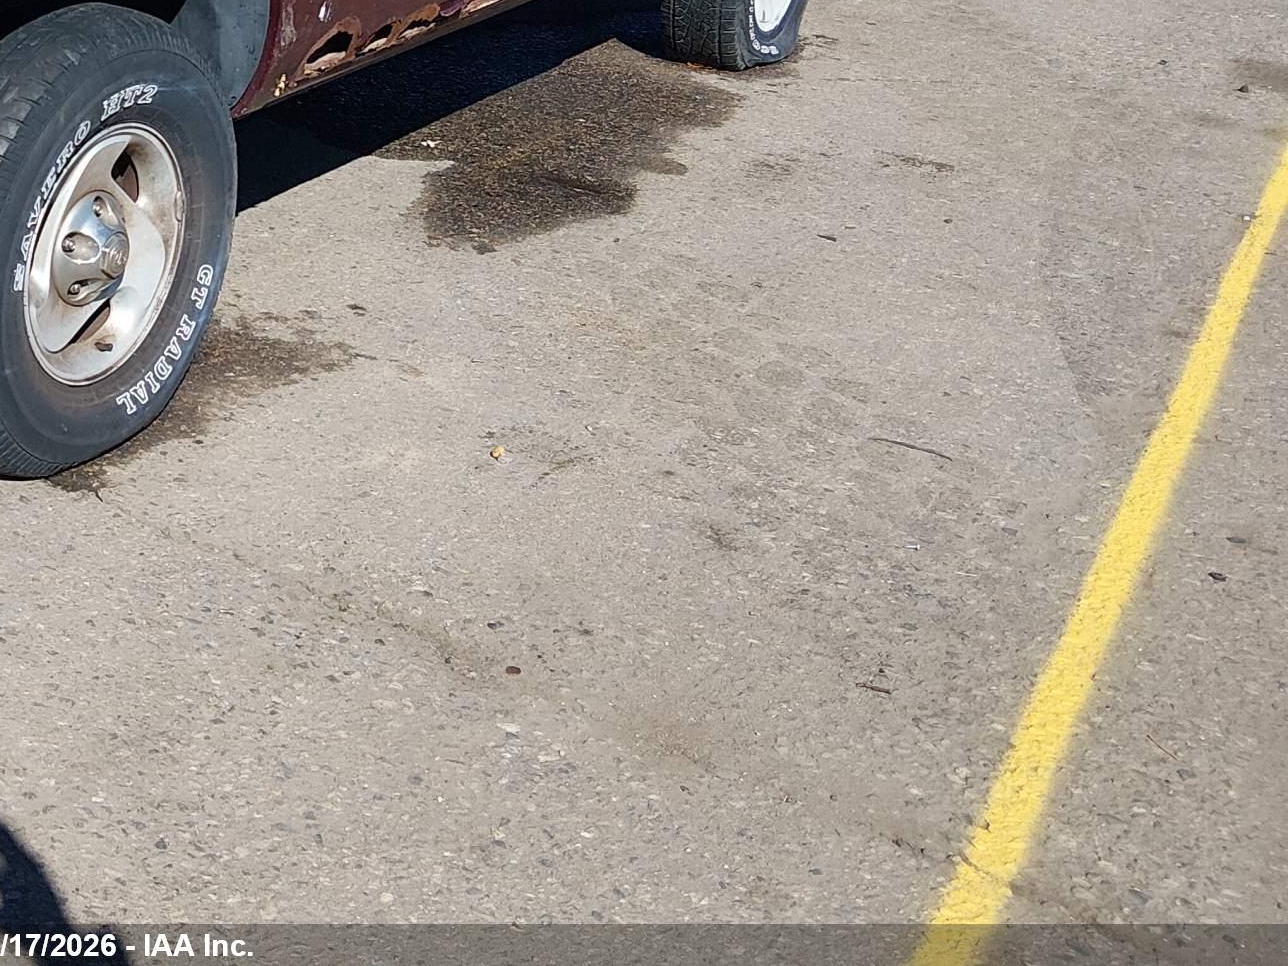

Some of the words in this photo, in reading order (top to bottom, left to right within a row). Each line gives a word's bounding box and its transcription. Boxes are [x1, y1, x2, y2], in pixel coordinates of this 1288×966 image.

[12, 120, 91, 292] SAVERO
[101, 84, 159, 122] HT2
[190, 264, 214, 310] GT
[116, 313, 197, 415] RADIAL
